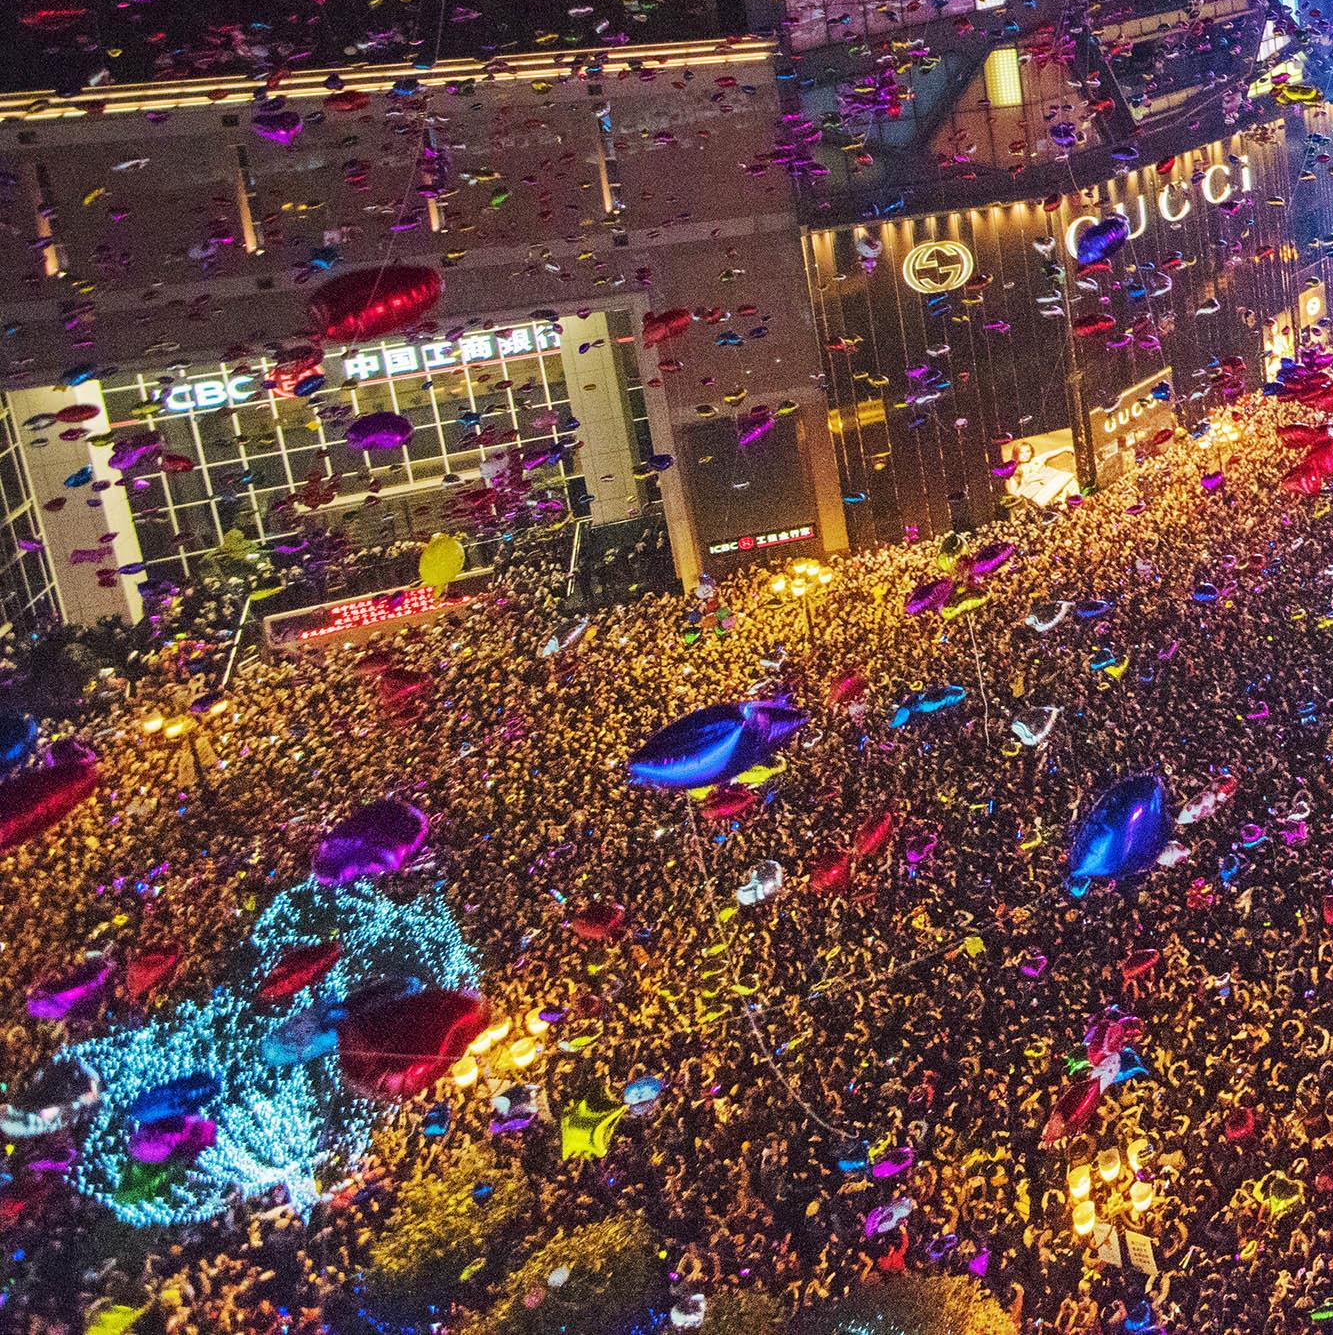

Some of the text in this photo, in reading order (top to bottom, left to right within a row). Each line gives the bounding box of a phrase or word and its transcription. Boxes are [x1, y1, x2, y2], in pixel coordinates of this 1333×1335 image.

[153, 322, 562, 412] CBC 中国工商银行
[709, 541, 739, 554] ICBC
